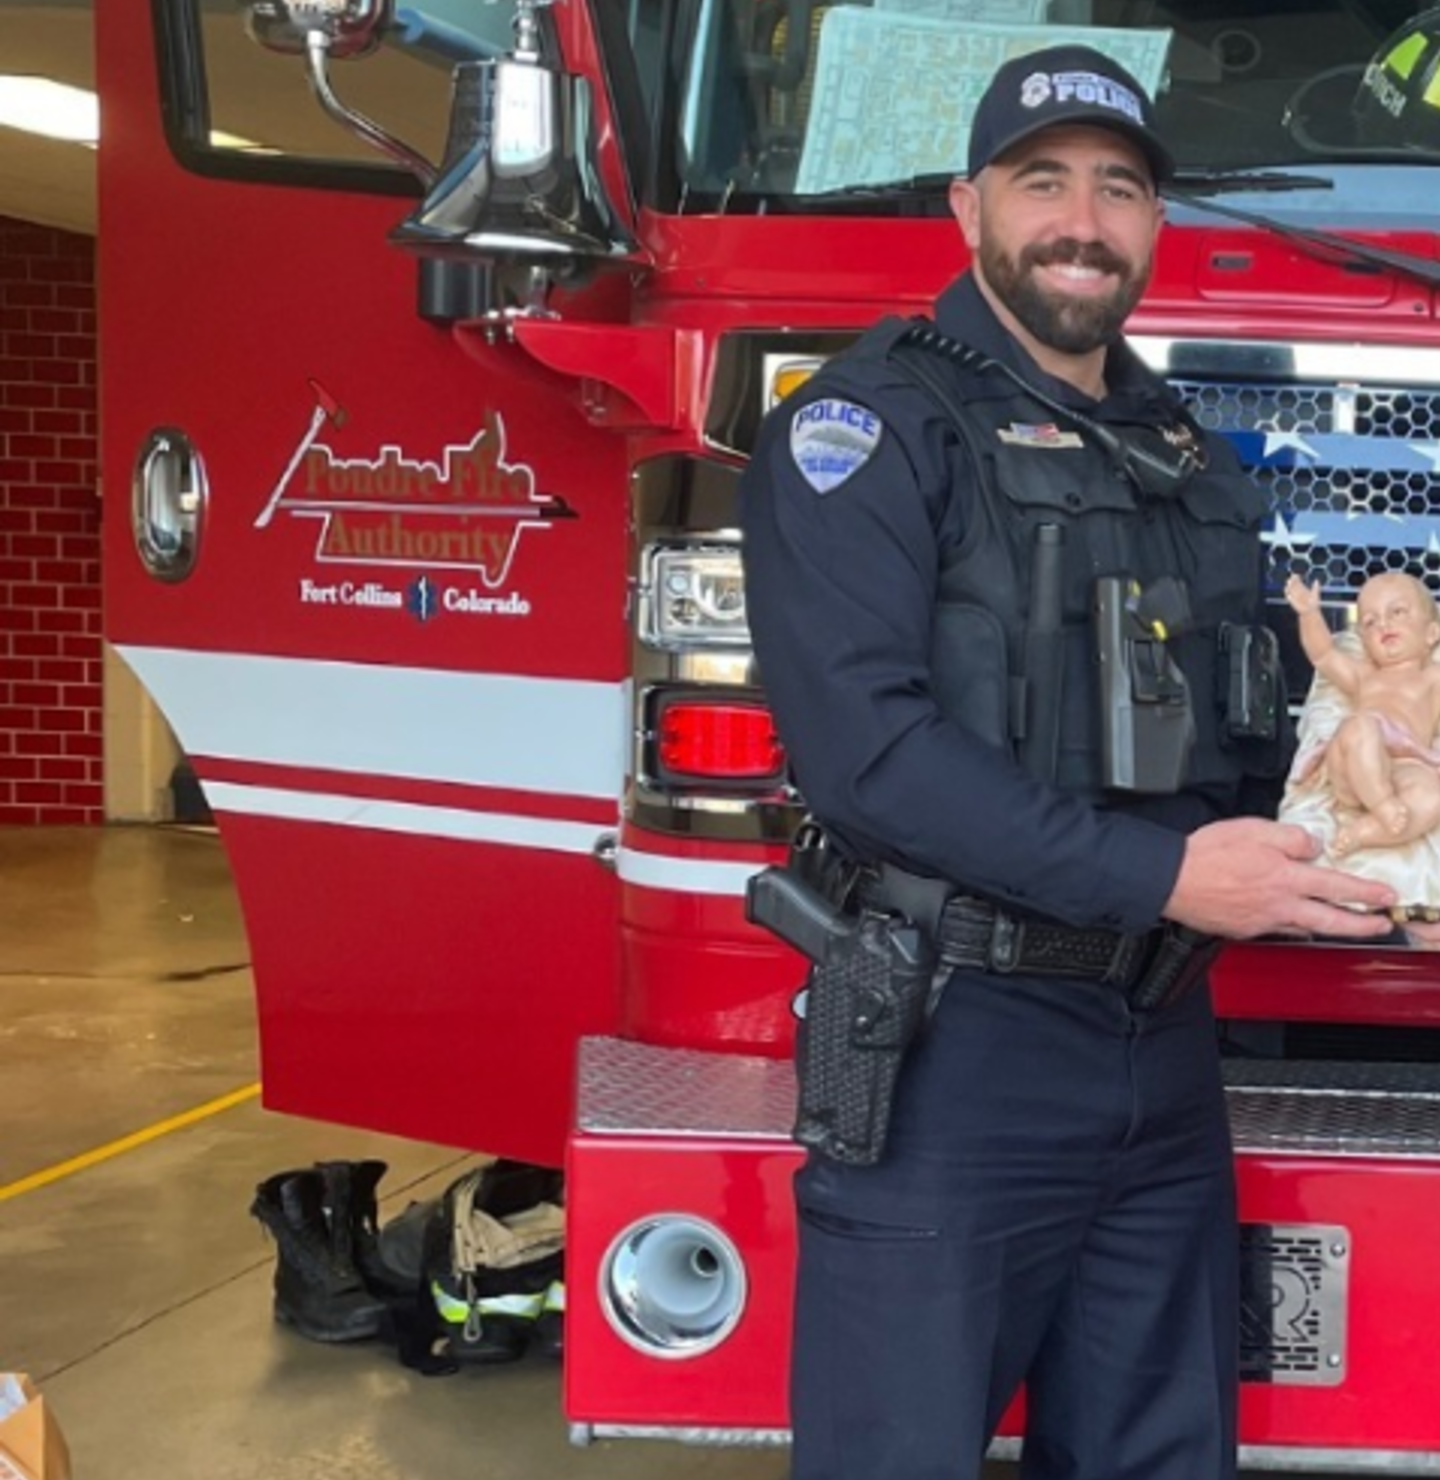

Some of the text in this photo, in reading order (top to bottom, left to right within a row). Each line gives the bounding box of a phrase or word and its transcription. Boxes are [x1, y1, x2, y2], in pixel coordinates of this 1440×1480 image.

[796, 401, 877, 437] POLICE
[304, 455, 530, 499] Poudre Fire
[326, 512, 511, 577] Authority
[300, 579, 531, 615] Fort Collins Colorado
